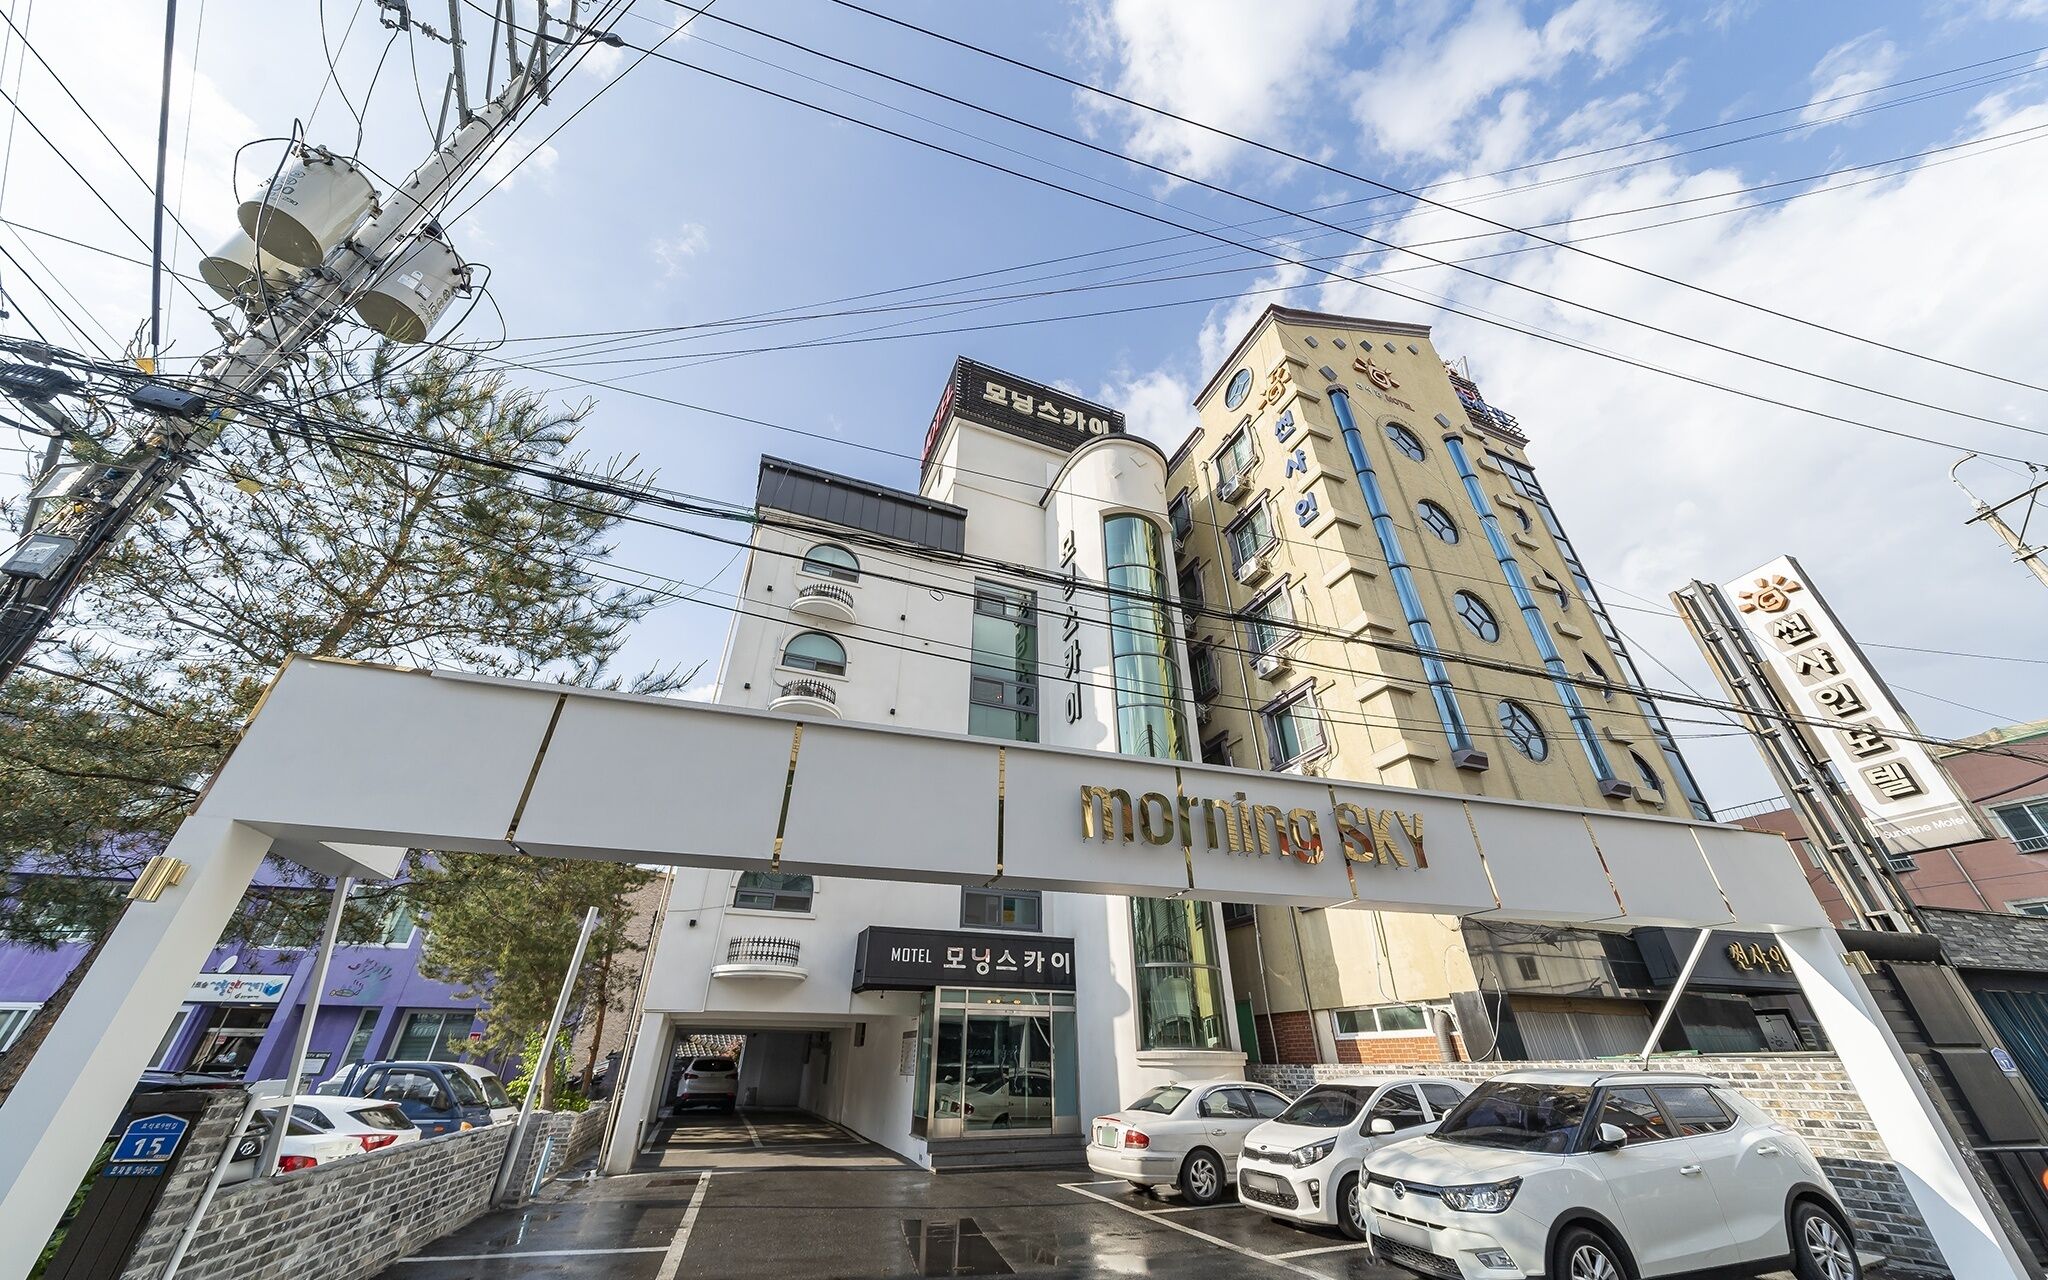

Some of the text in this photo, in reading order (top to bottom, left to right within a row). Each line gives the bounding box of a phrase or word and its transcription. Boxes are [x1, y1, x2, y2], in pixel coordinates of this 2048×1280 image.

[983, 381, 1110, 435] 모닝스카이
[1275, 409, 1320, 528] 썬샤인
[1060, 529, 1083, 725] 모닝스카이
[1080, 785, 1429, 870] morning SKY
[1883, 815, 1968, 839] Sunshine Motel
[891, 946, 1070, 976] MOTEL 모닝스카이
[1728, 941, 1792, 974] 썬샤인
[133, 1137, 166, 1157] 15
